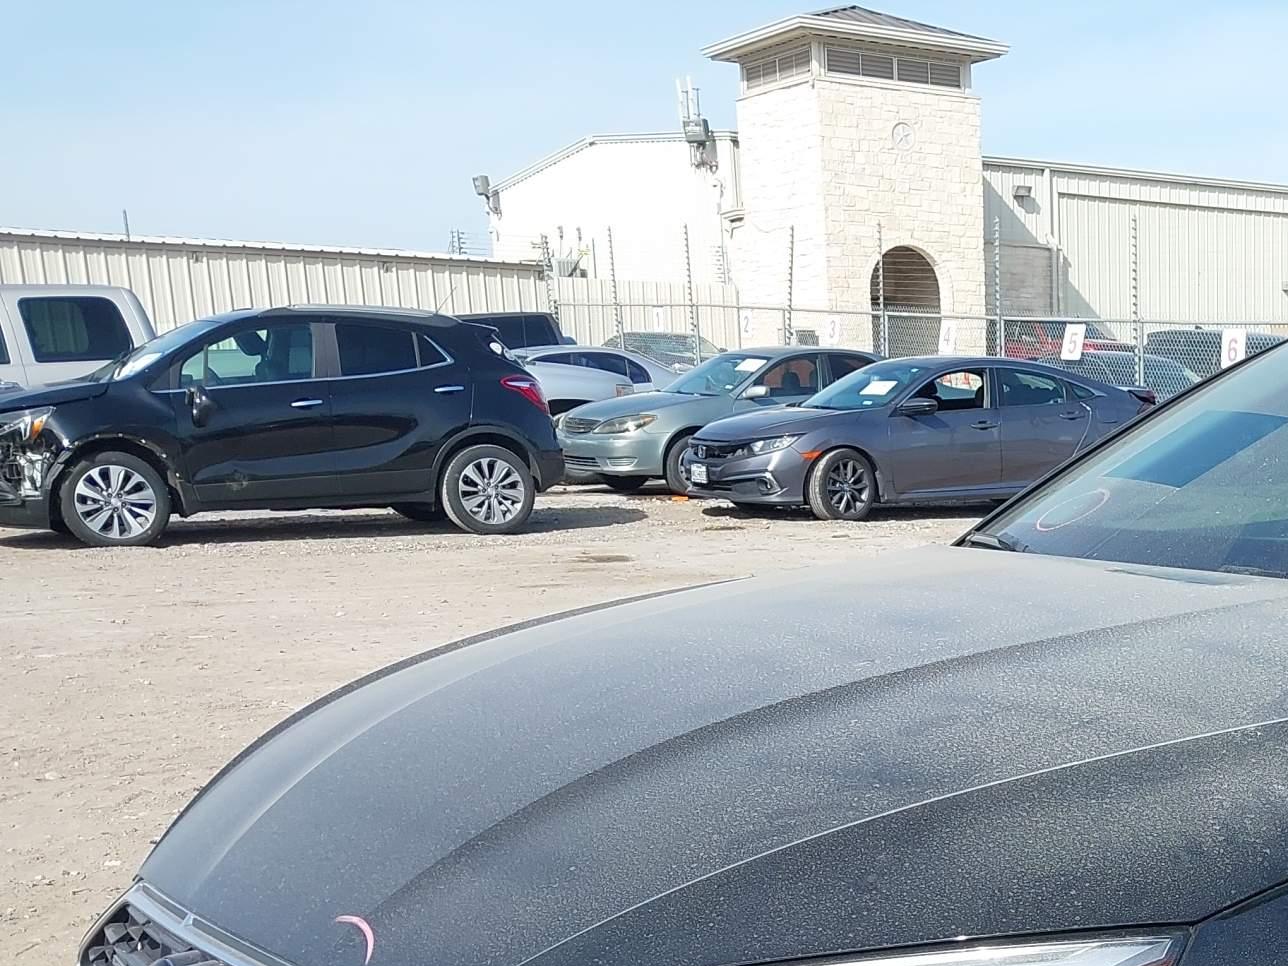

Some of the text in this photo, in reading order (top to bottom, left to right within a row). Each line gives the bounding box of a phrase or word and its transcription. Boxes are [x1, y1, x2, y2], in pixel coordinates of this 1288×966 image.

[828, 319, 836, 338] 3
[943, 326, 951, 345] 4
[1068, 332, 1079, 354] 5
[1227, 337, 1238, 362] 6
